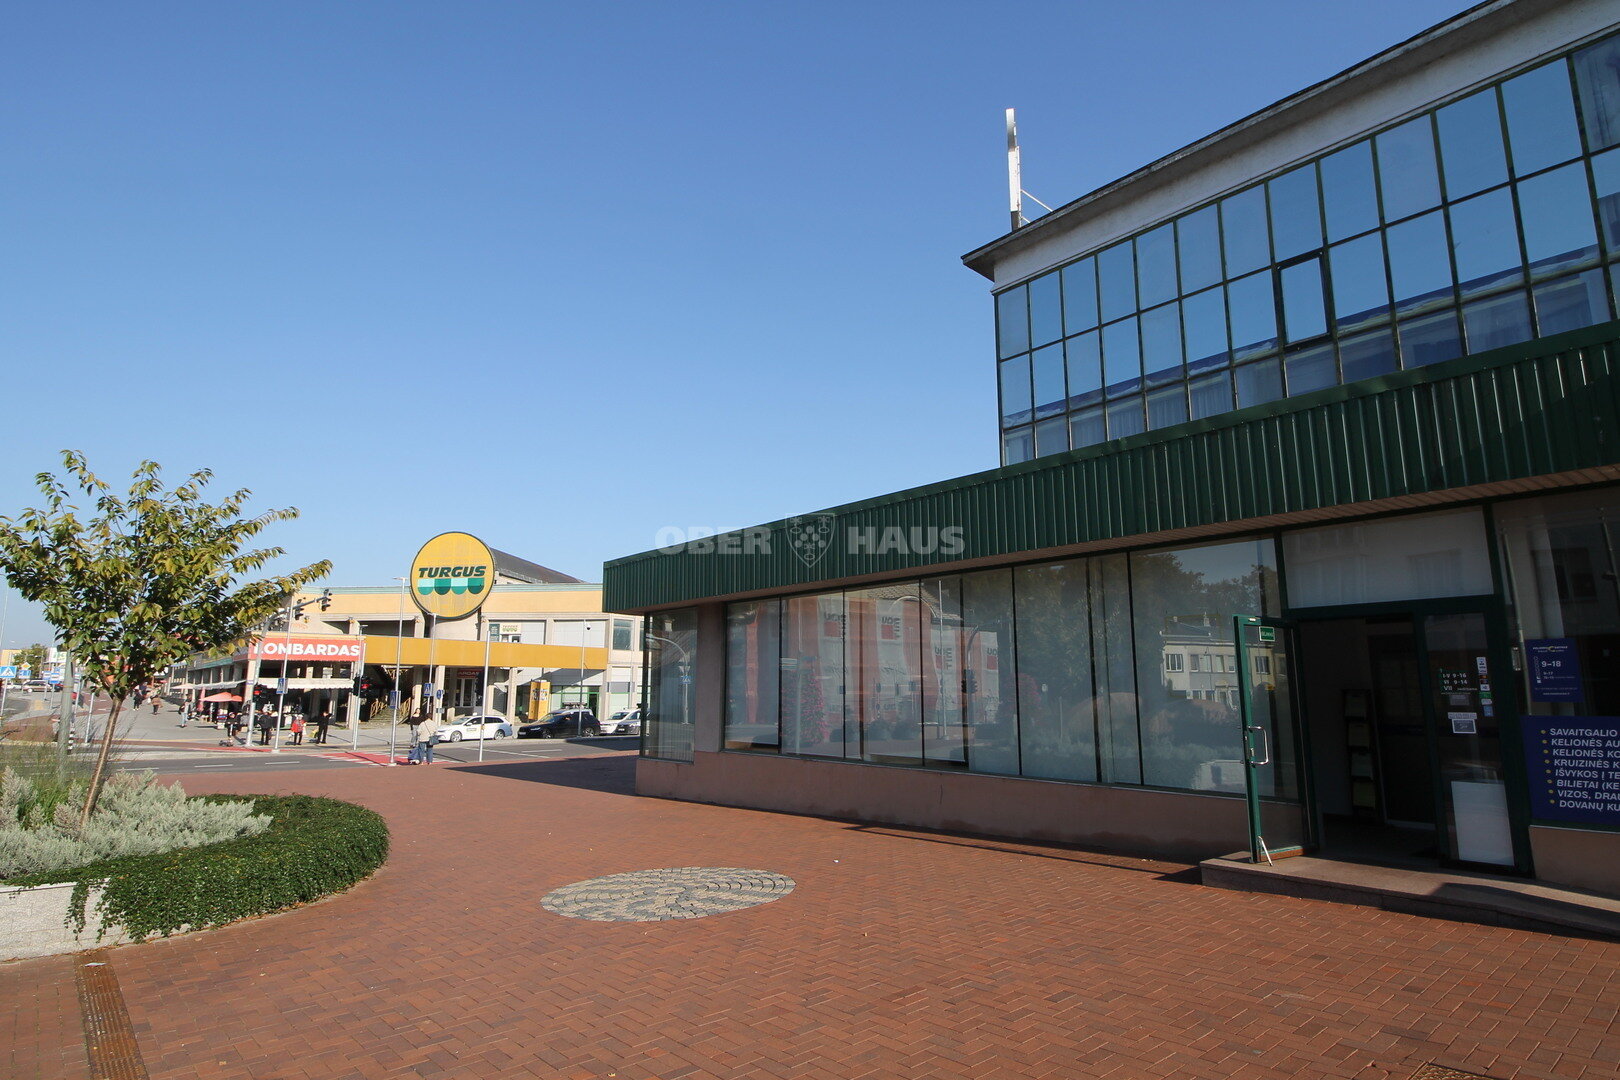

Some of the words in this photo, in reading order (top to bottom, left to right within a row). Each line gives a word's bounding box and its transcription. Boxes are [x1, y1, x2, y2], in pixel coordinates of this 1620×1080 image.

[418, 566, 486, 578] TURGUS
[1550, 728, 1617, 737] SAVAITGALIO
[1551, 738, 1602, 747] KELIONĖS
[1553, 749, 1604, 757] KELIONĖS
[1554, 759, 1609, 768] KRUIZINĖS
[1555, 767, 1598, 778] IŠVYKOS
[1557, 780, 1599, 788] BILIETAI
[1560, 800, 1604, 812] DOVANŲ
